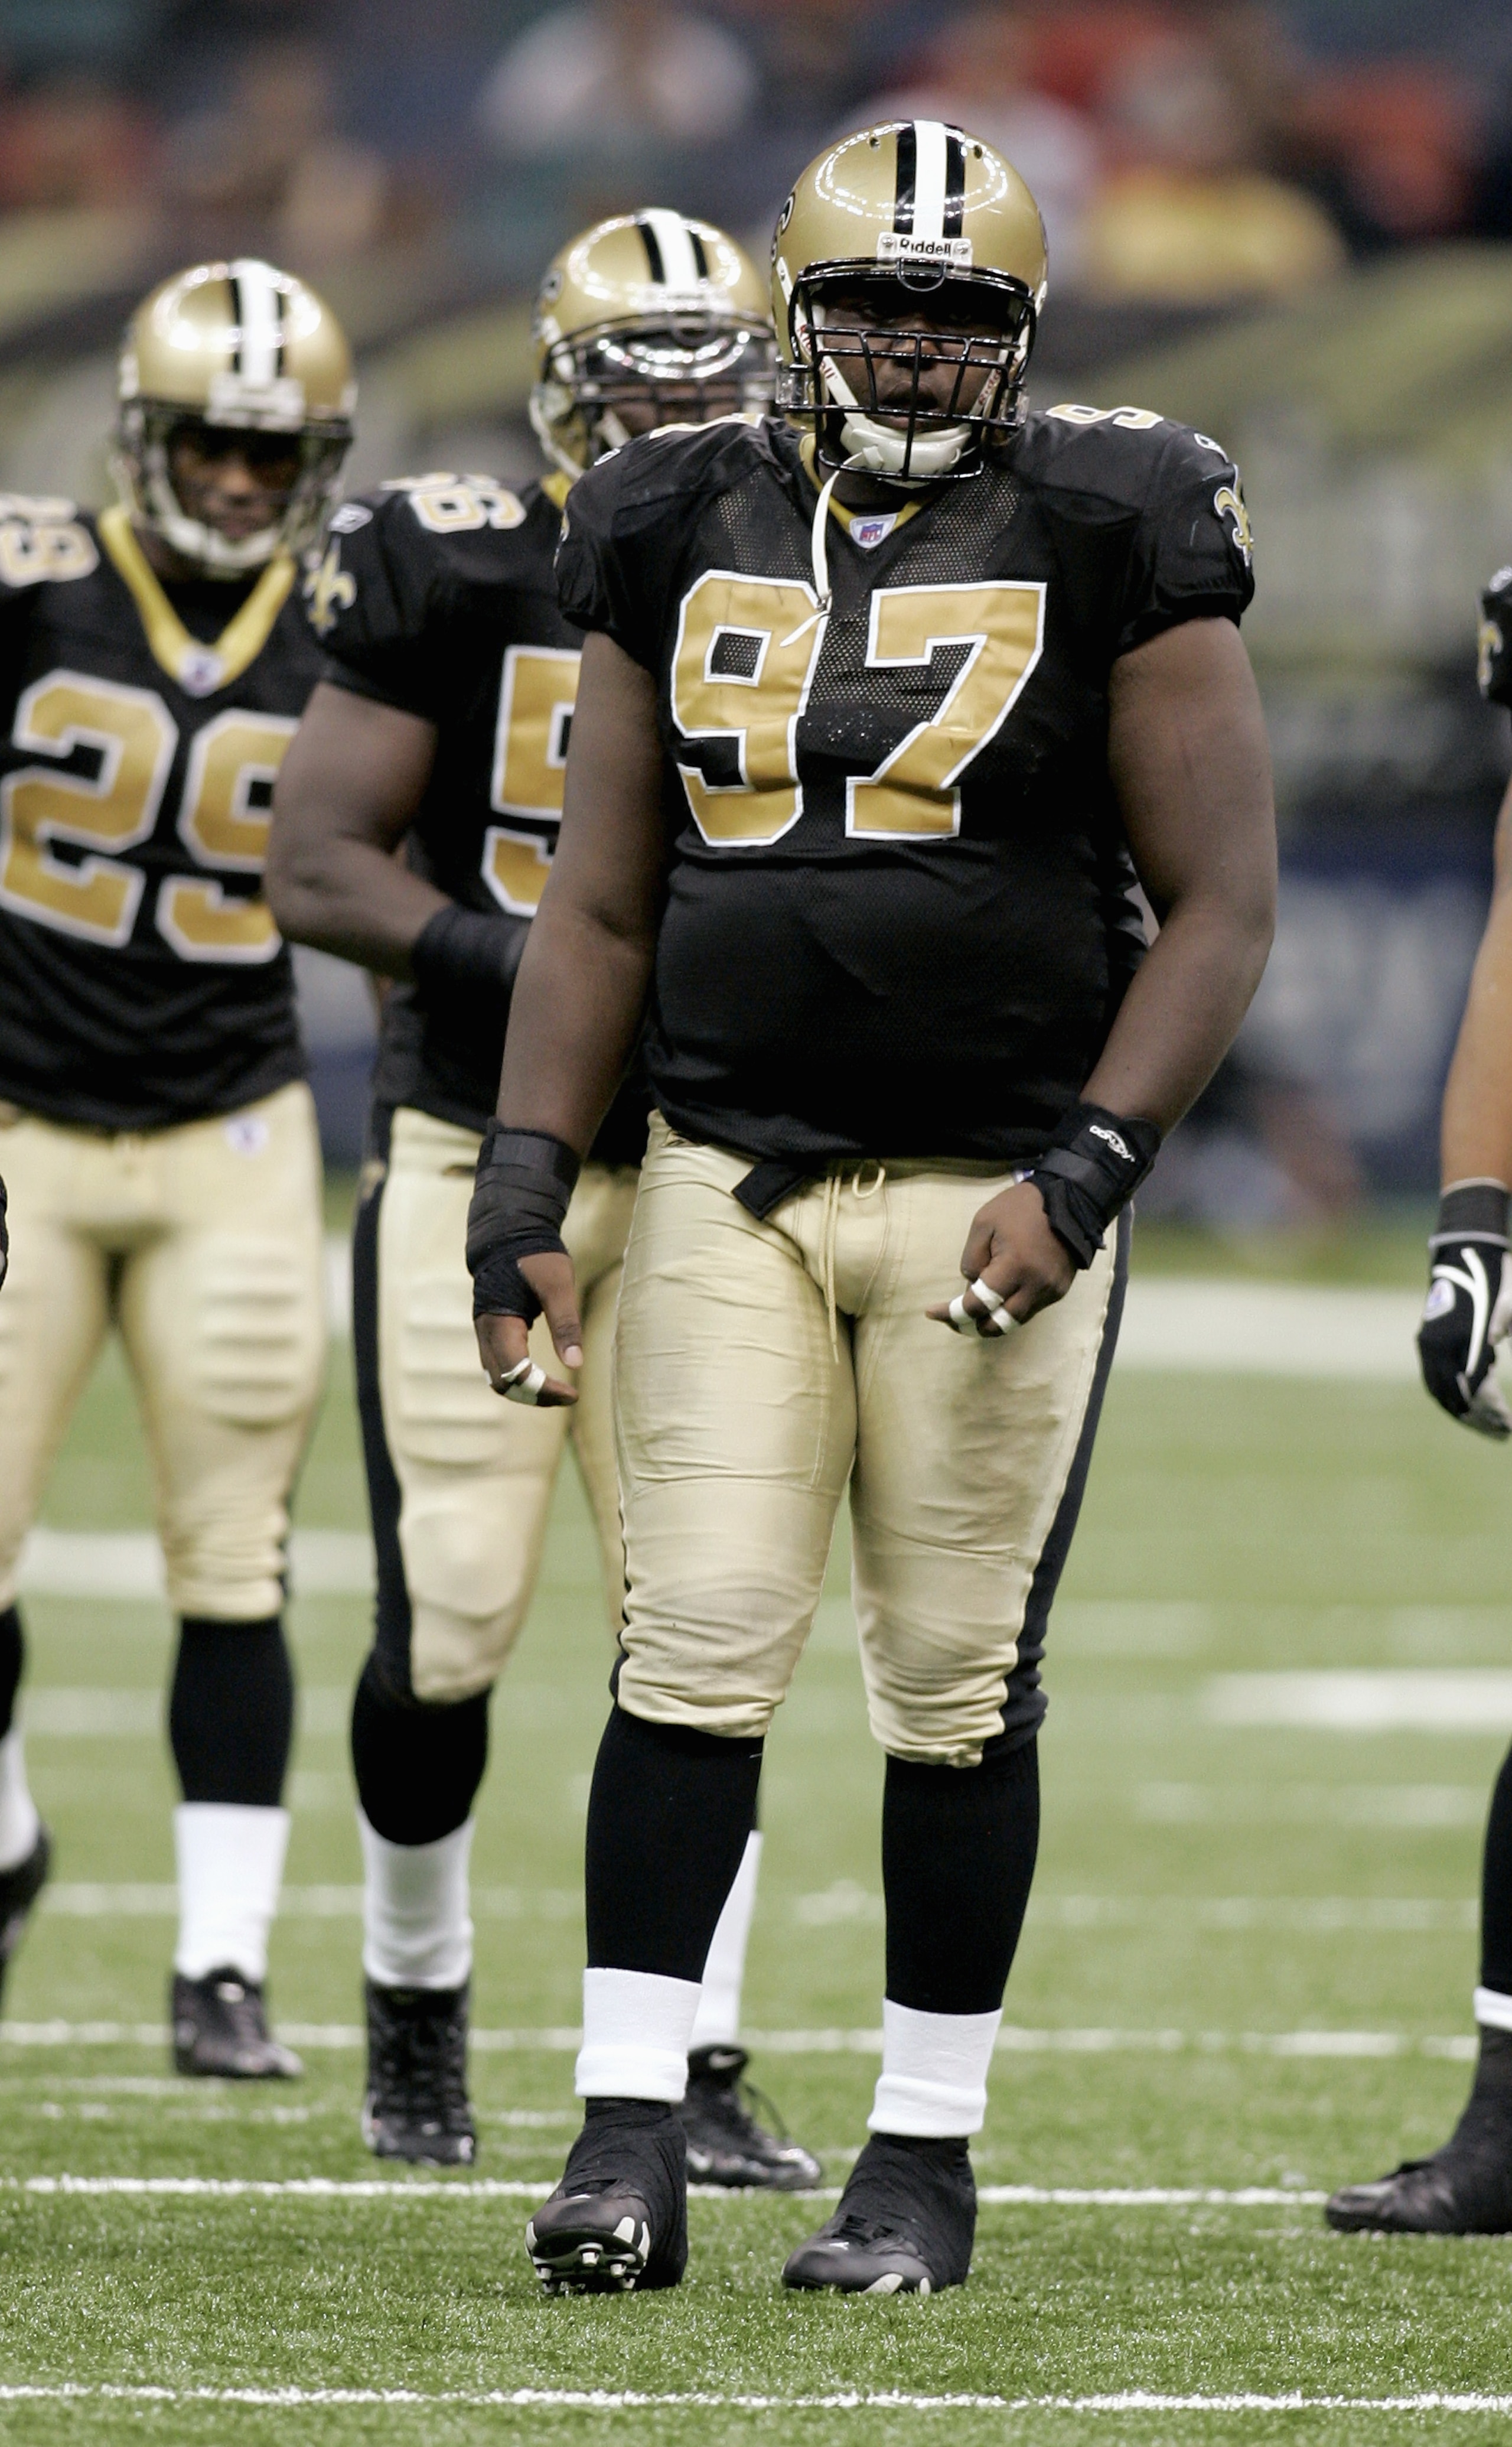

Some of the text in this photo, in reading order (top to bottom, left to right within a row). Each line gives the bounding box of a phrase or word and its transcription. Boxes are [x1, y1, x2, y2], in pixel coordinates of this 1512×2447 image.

[900, 237, 953, 257] Riddell
[0, 668, 300, 964] 29
[670, 568, 1047, 847] 97
